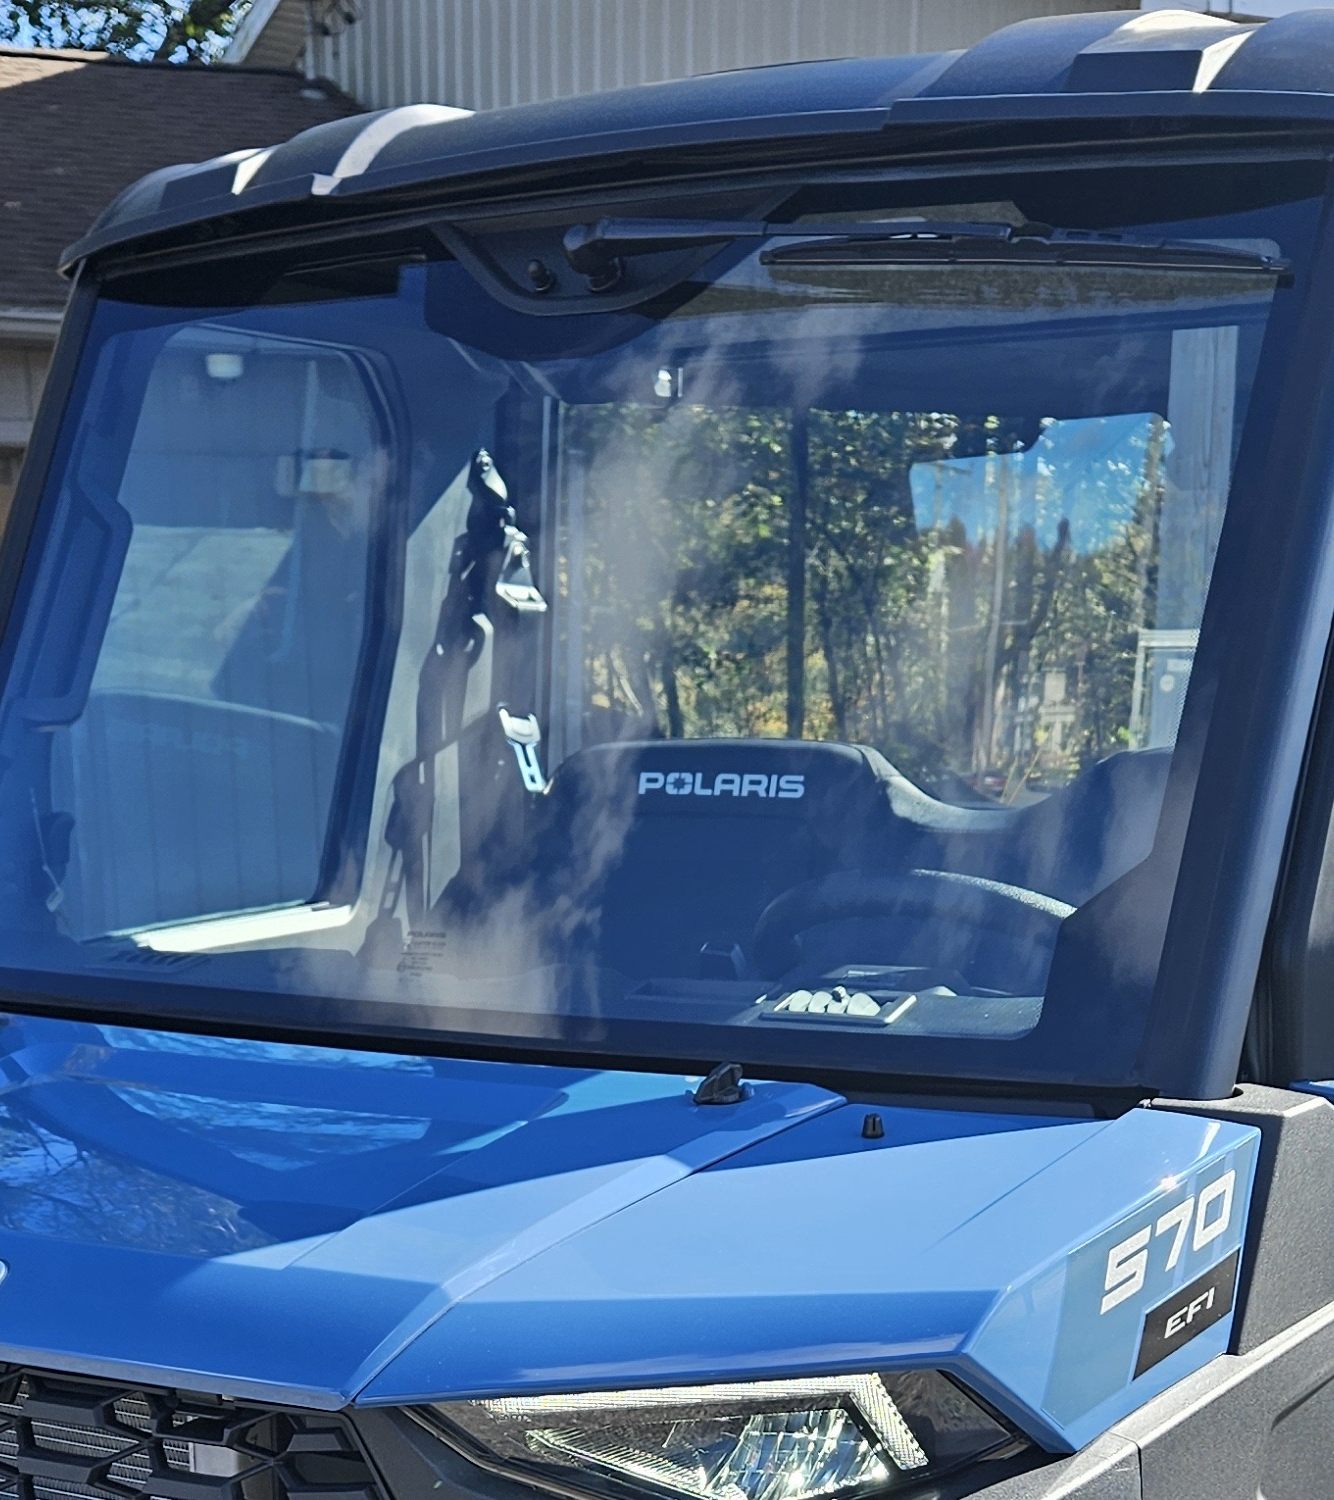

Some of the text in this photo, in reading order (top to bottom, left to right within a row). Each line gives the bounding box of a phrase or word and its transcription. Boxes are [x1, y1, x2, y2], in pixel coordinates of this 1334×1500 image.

[638, 771, 805, 799] POLARIS
[1099, 1169, 1236, 1316] 570
[1163, 1286, 1216, 1339] EFI
